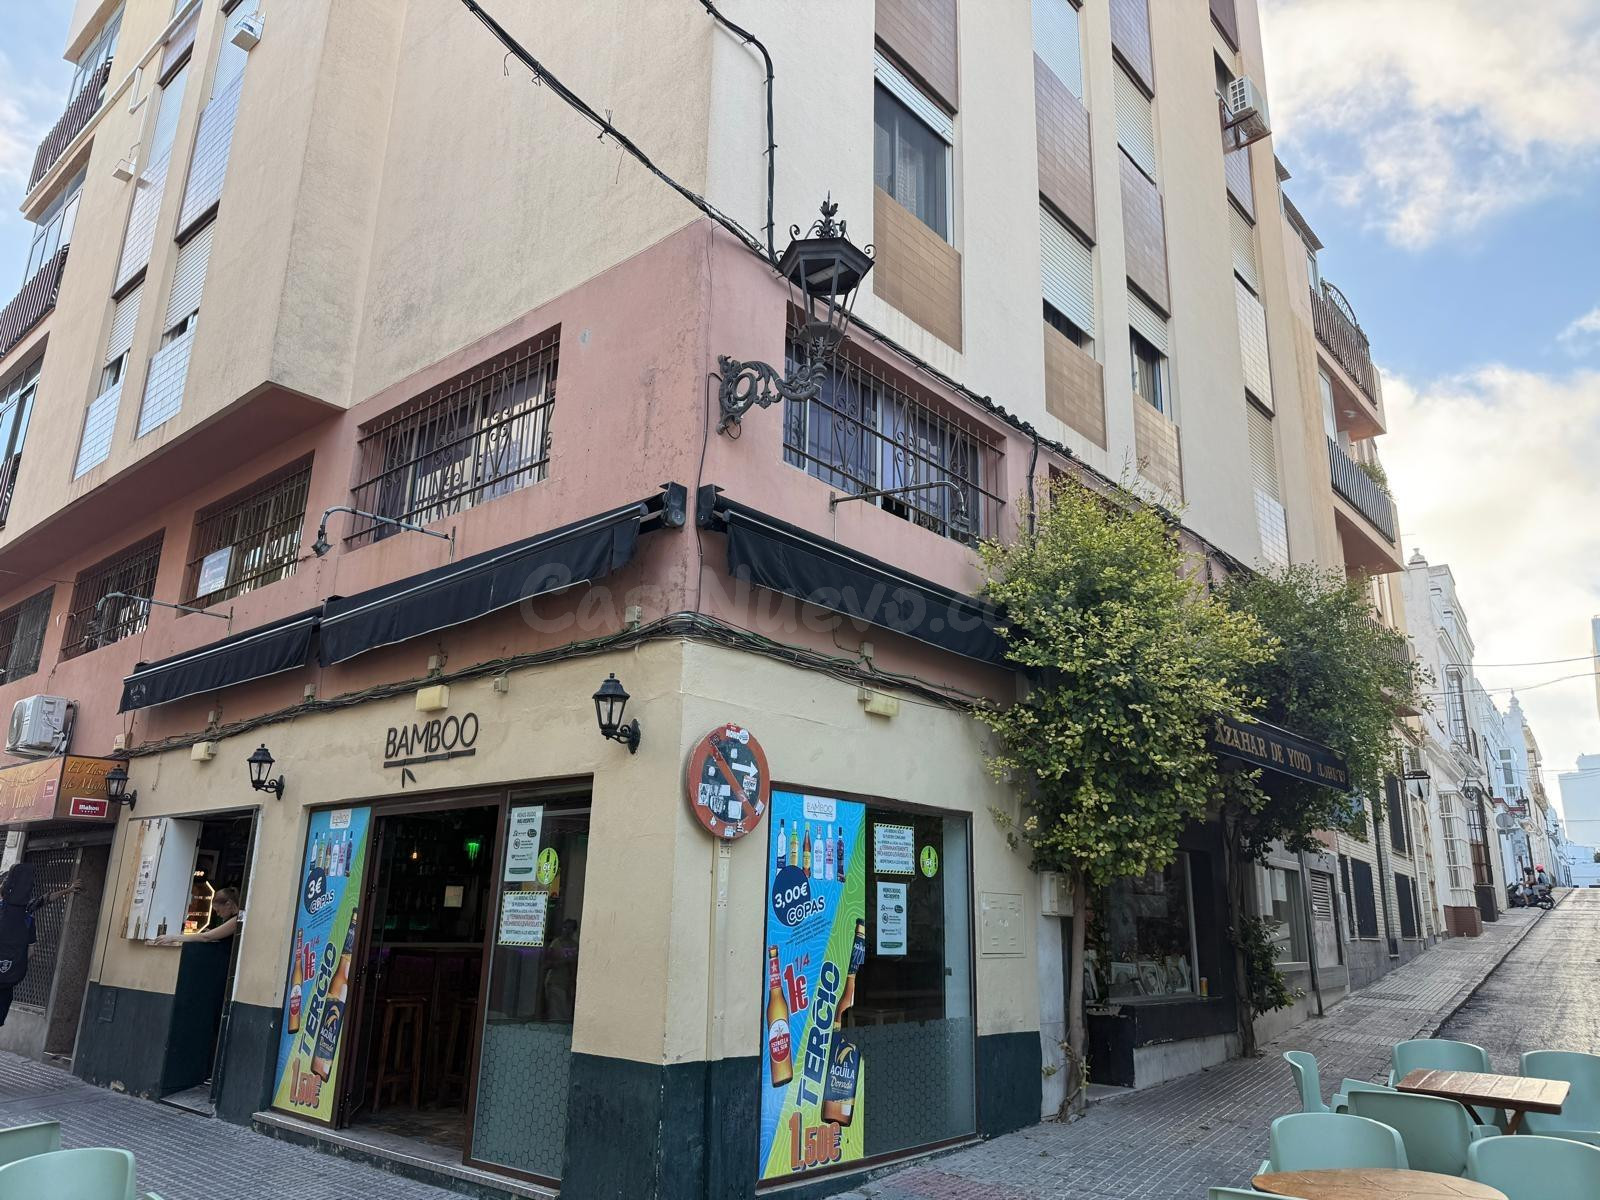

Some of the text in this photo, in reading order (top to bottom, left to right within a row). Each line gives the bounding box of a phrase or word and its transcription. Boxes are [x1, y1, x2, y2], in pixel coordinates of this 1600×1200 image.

[385, 712, 479, 759] BAMBOO
[1215, 722, 1268, 759] AZAHAR
[1270, 741, 1284, 764] DE
[1286, 748, 1312, 773] YOYO
[806, 802, 834, 813] BAMBOO
[307, 876, 323, 899] 3€
[309, 889, 335, 913] COPAS
[774, 881, 808, 908] 3,00€
[786, 896, 826, 926] COPAS
[795, 952, 810, 971] 1/4
[299, 942, 337, 1057] TERCIO
[784, 963, 809, 1016] 1€
[796, 960, 841, 1107] TERCIO
[788, 1111, 843, 1173] 1,50€
